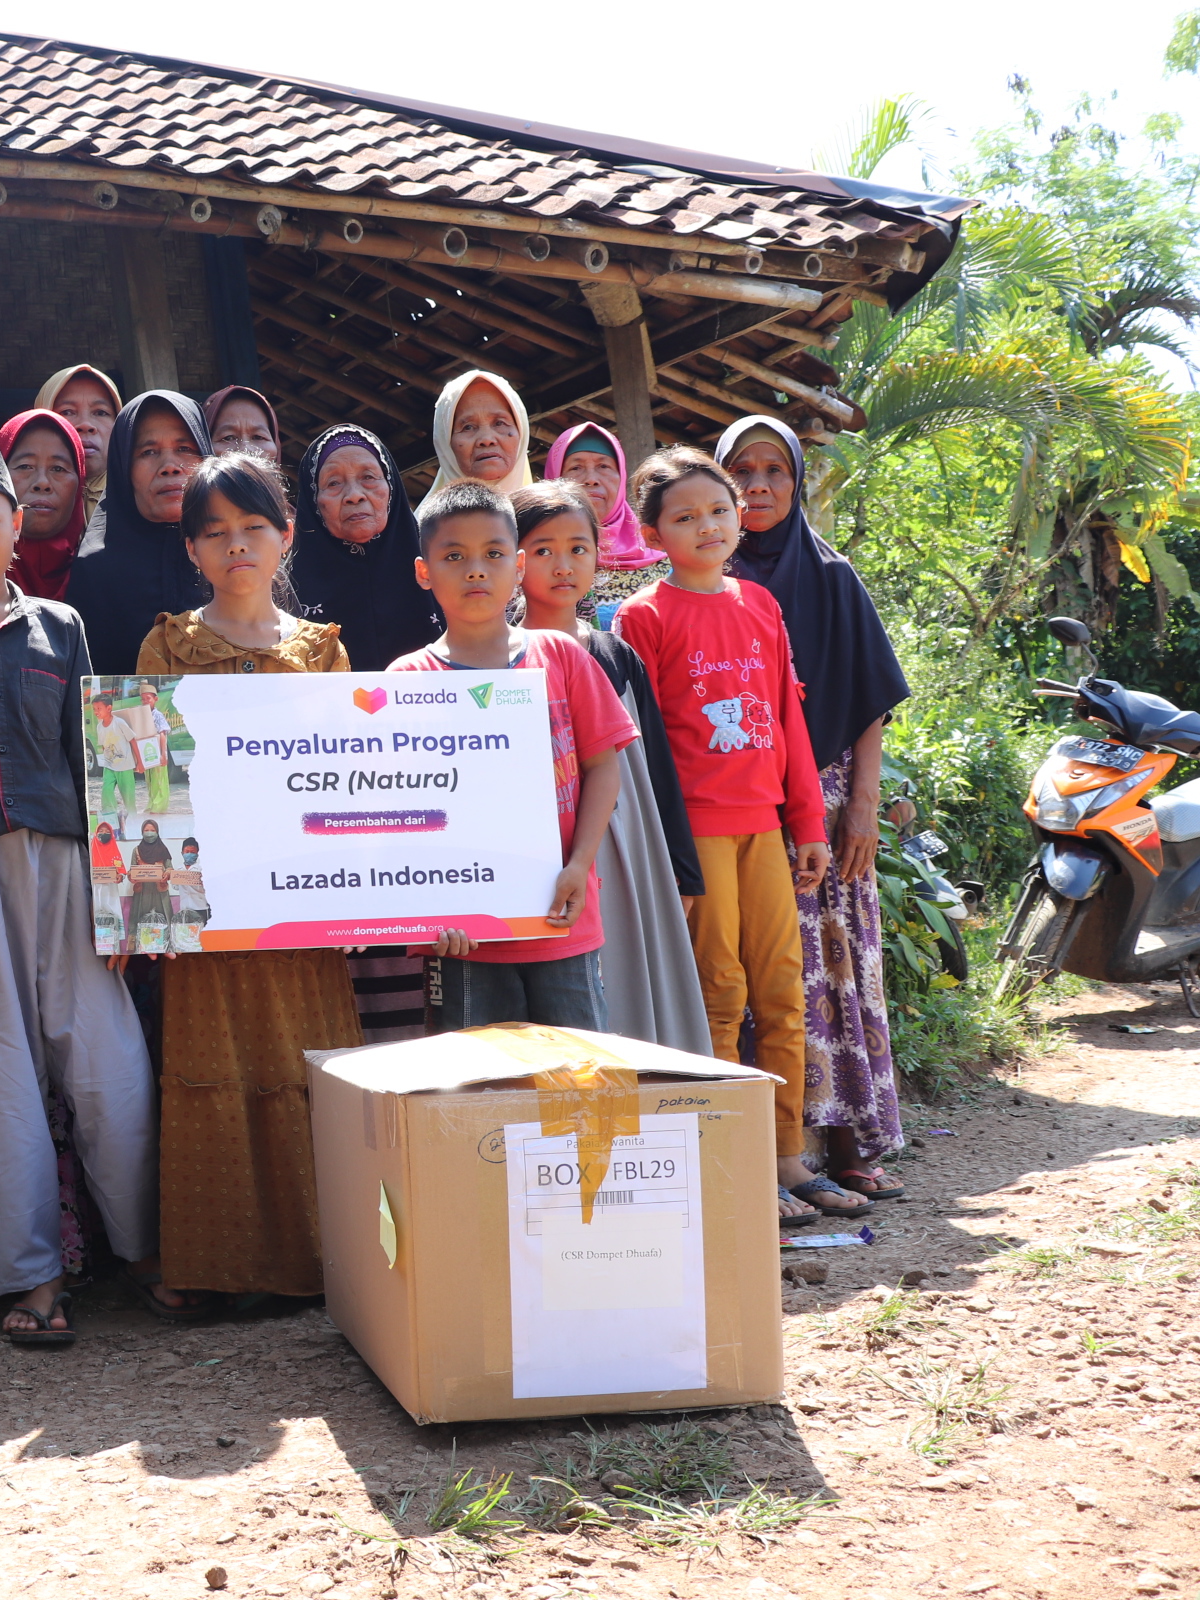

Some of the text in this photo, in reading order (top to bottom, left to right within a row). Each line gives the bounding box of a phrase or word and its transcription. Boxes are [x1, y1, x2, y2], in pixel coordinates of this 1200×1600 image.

[688, 650, 766, 682] Love you
[395, 688, 457, 705] Lazada
[495, 688, 531, 698] DOMPET
[496, 697, 533, 706] DHUAFA
[226, 732, 510, 760] Penyaluran Program
[286, 767, 459, 795] CSR (Natura)
[324, 815, 426, 828] Persembahan dari
[1123, 817, 1153, 831] HONDA
[270, 861, 495, 891] Lazada Indonesia
[326, 924, 445, 937] www.dompetdhuafa.org
[655, 1096, 711, 1114] pakaian
[566, 1138, 600, 1149] Pakaia
[537, 1159, 676, 1187] BOX FBL29
[560, 1248, 662, 1261] (CSR Dompet Dhuafa)
